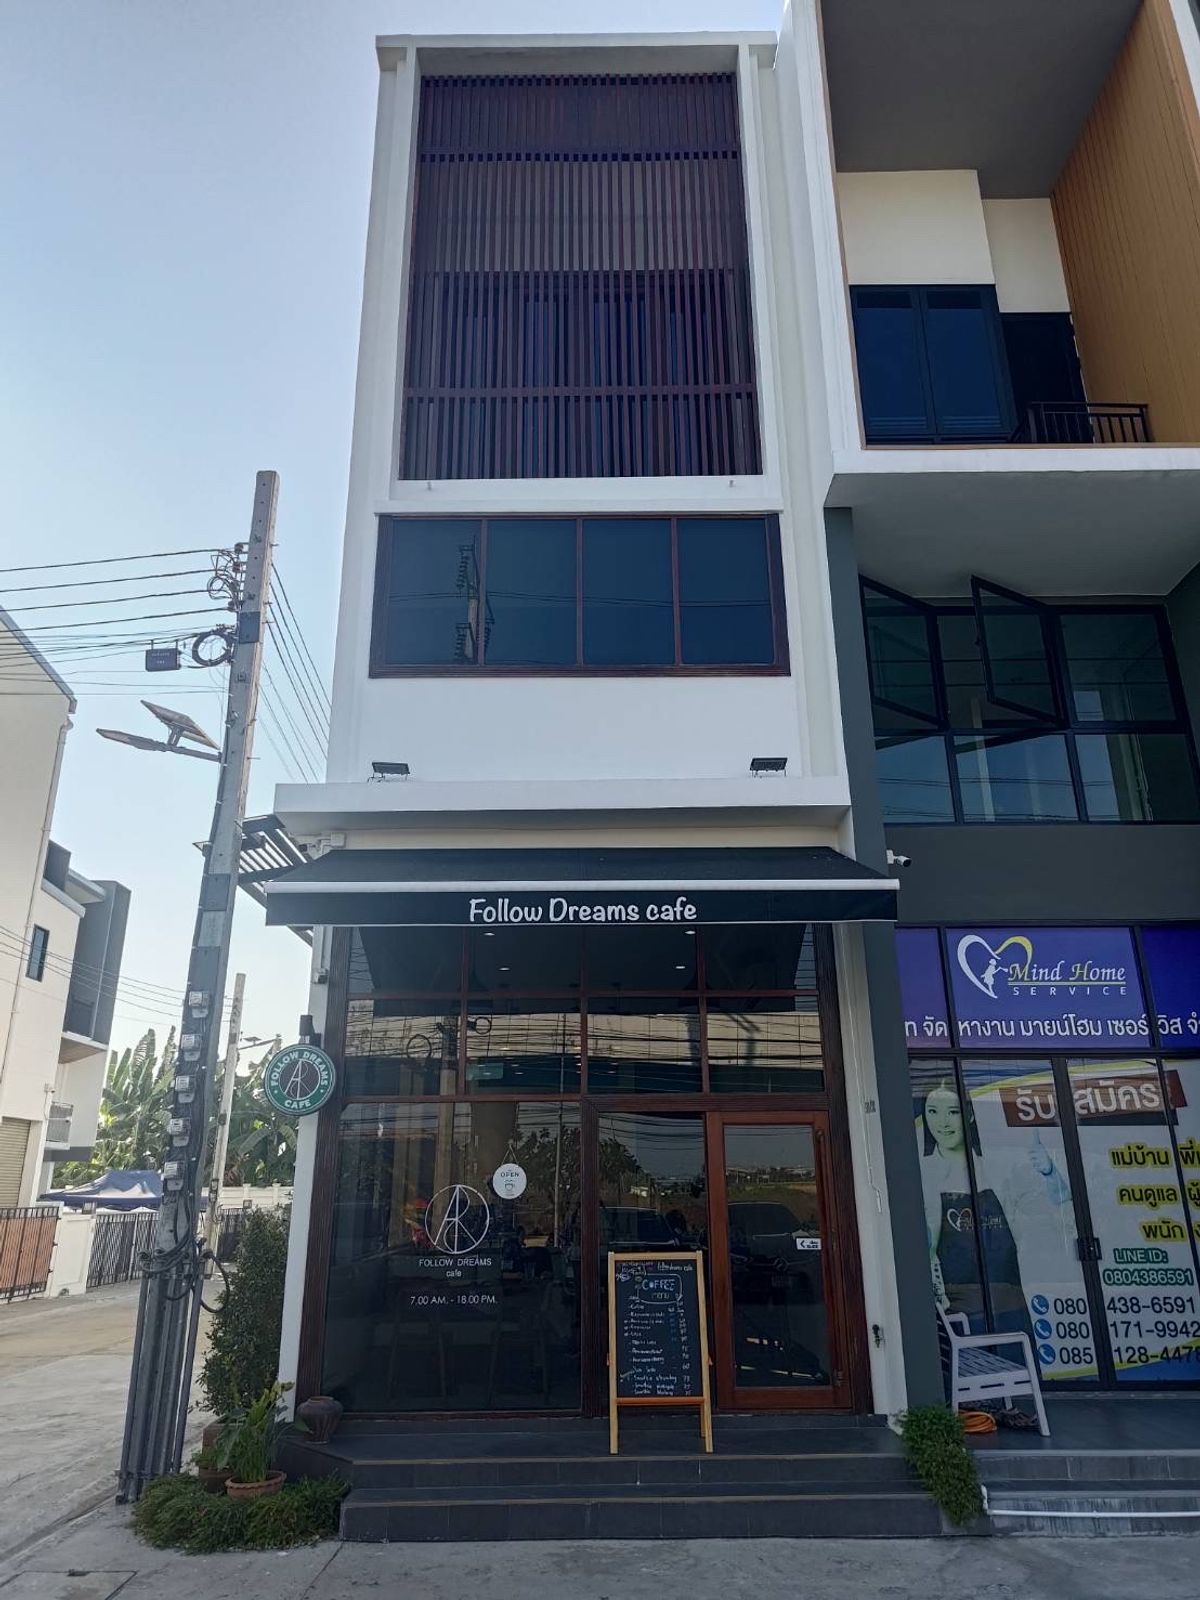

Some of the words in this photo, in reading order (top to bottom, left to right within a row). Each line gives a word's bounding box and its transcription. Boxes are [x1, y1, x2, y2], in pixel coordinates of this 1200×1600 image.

[469, 898, 543, 923] Follow
[549, 897, 640, 922] Dreams
[646, 896, 698, 922] cafe
[1007, 960, 1065, 981] Mind
[1071, 960, 1127, 981] Home
[1013, 986, 1127, 996] SERVICE
[270, 1051, 299, 1087] FOLLOW
[302, 1051, 329, 1086] DREAMS
[284, 1099, 312, 1109] CAFE
[1015, 1087, 1057, 1122] รับ
[1073, 1079, 1161, 1115] สมัคร
[1111, 1145, 1170, 1166] แม่บ้าน
[1118, 1187, 1178, 1207] คนดูแล
[419, 1258, 453, 1267] FOLLOW
[457, 1257, 492, 1266] DREAMS
[1114, 1248, 1146, 1263] LINE
[1148, 1248, 1168, 1263] ID:
[446, 1268, 462, 1278] cafe
[1103, 1269, 1193, 1286] 0804386591
[410, 1295, 429, 1305] 7.00
[1053, 1297, 1088, 1315] 080
[1106, 1296, 1196, 1314] 438-6591
[1056, 1321, 1090, 1339] 080
[1109, 1320, 1200, 1338] 171-9942
[1059, 1346, 1094, 1365] 085
